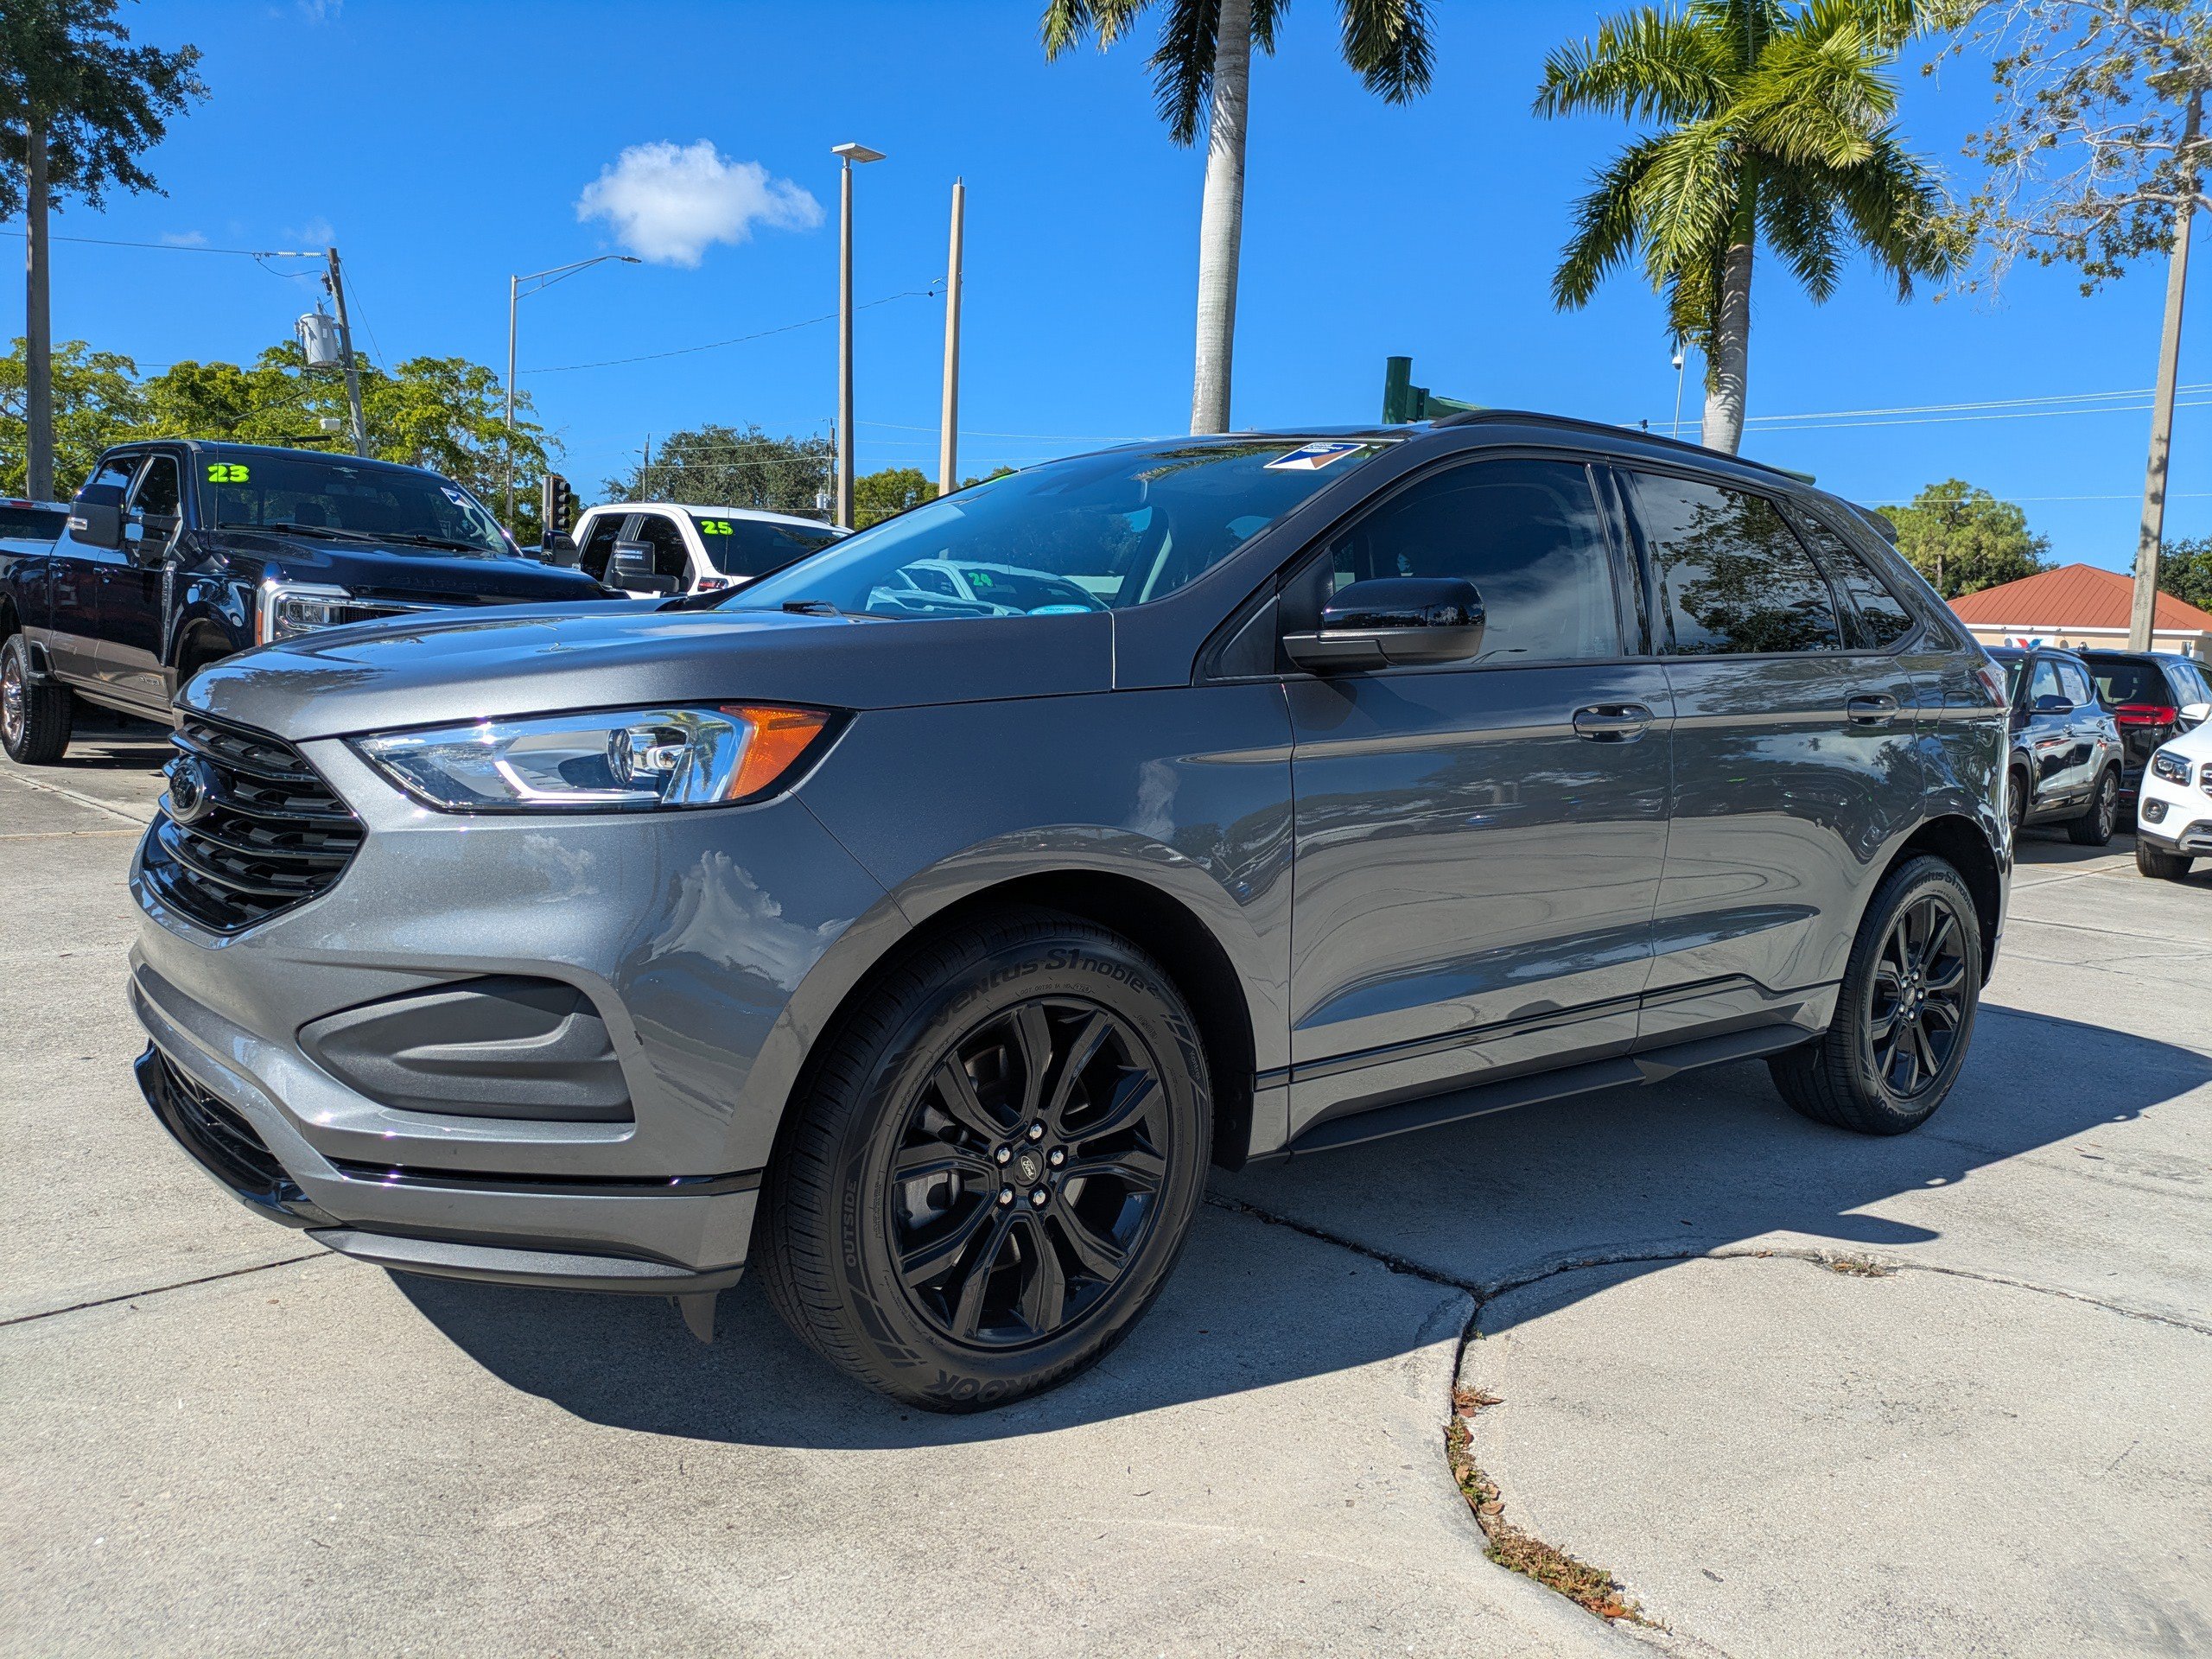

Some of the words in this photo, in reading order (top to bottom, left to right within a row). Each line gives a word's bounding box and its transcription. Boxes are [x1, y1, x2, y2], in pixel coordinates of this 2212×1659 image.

[208, 465, 250, 483] 23
[701, 520, 734, 535] 25
[968, 572, 994, 588] 24
[1021, 1159, 1036, 1178] Ford
[842, 1179, 858, 1268] OUTSIDE
